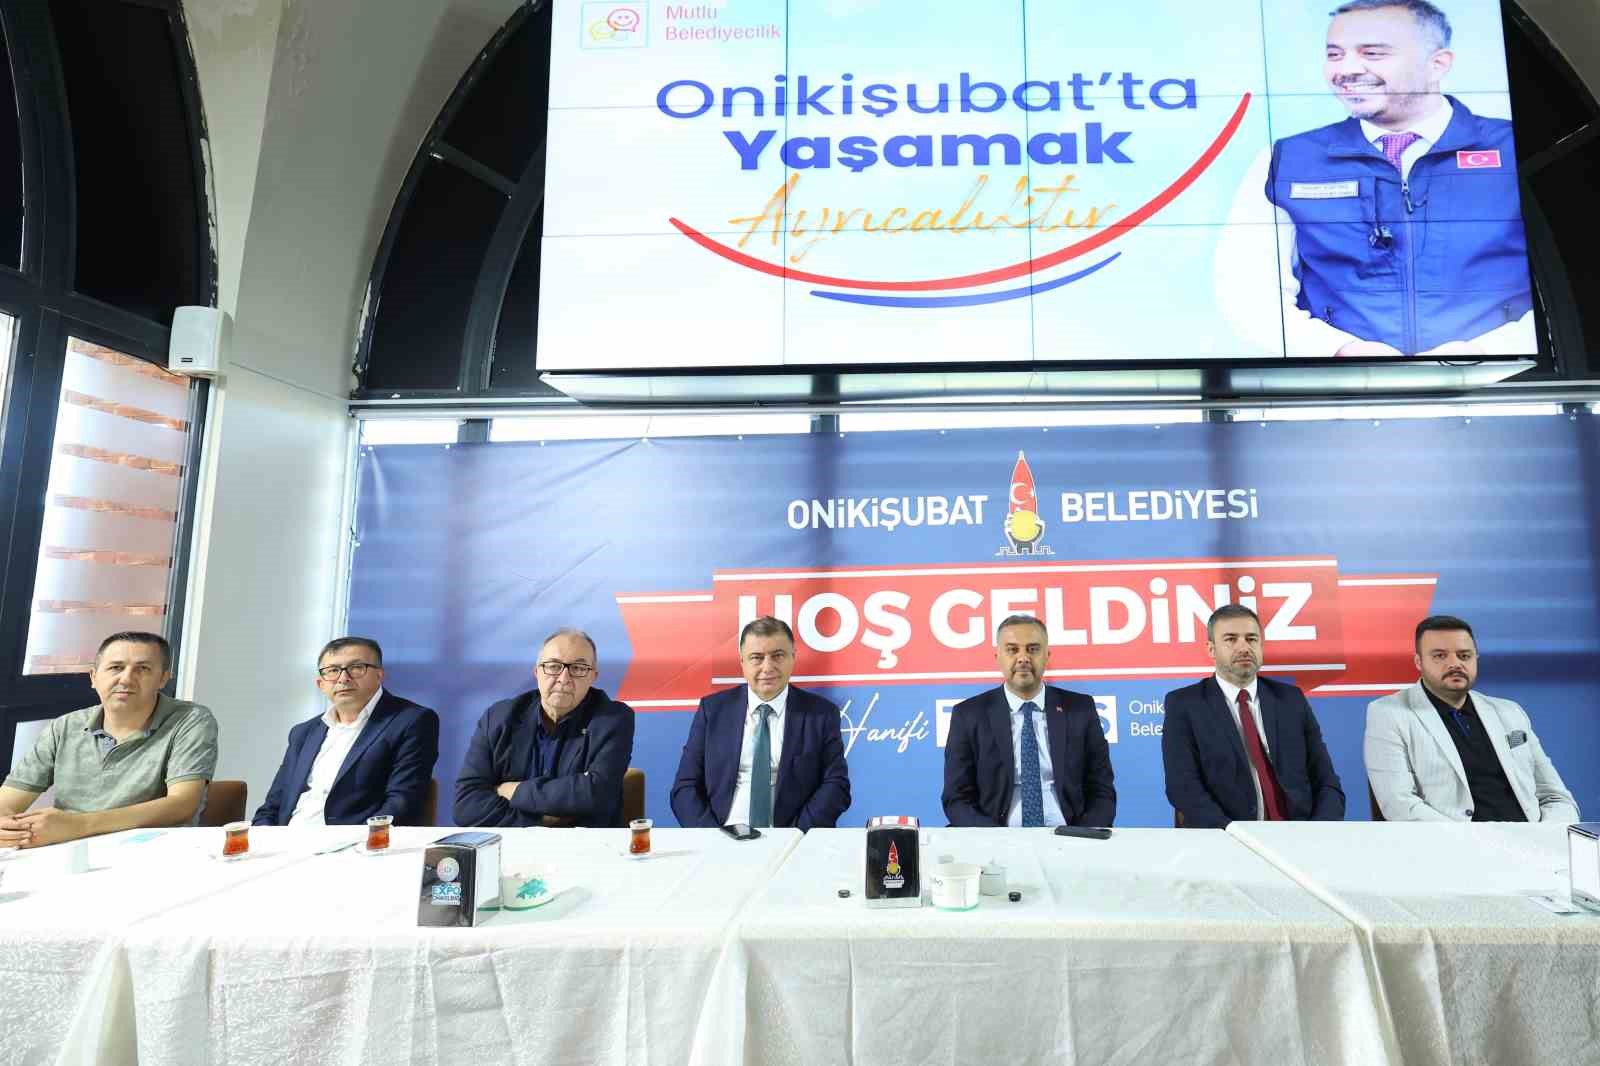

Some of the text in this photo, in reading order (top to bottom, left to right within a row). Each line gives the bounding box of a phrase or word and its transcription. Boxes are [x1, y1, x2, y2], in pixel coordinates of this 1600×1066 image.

[666, 5, 718, 20] Mutlu
[665, 24, 781, 42] Belediyecilik
[722, 122, 1136, 172] Yaşamak
[1129, 699, 1165, 715] Onik
[840, 691, 930, 758] Hanifi
[1130, 721, 1164, 737] Bele
